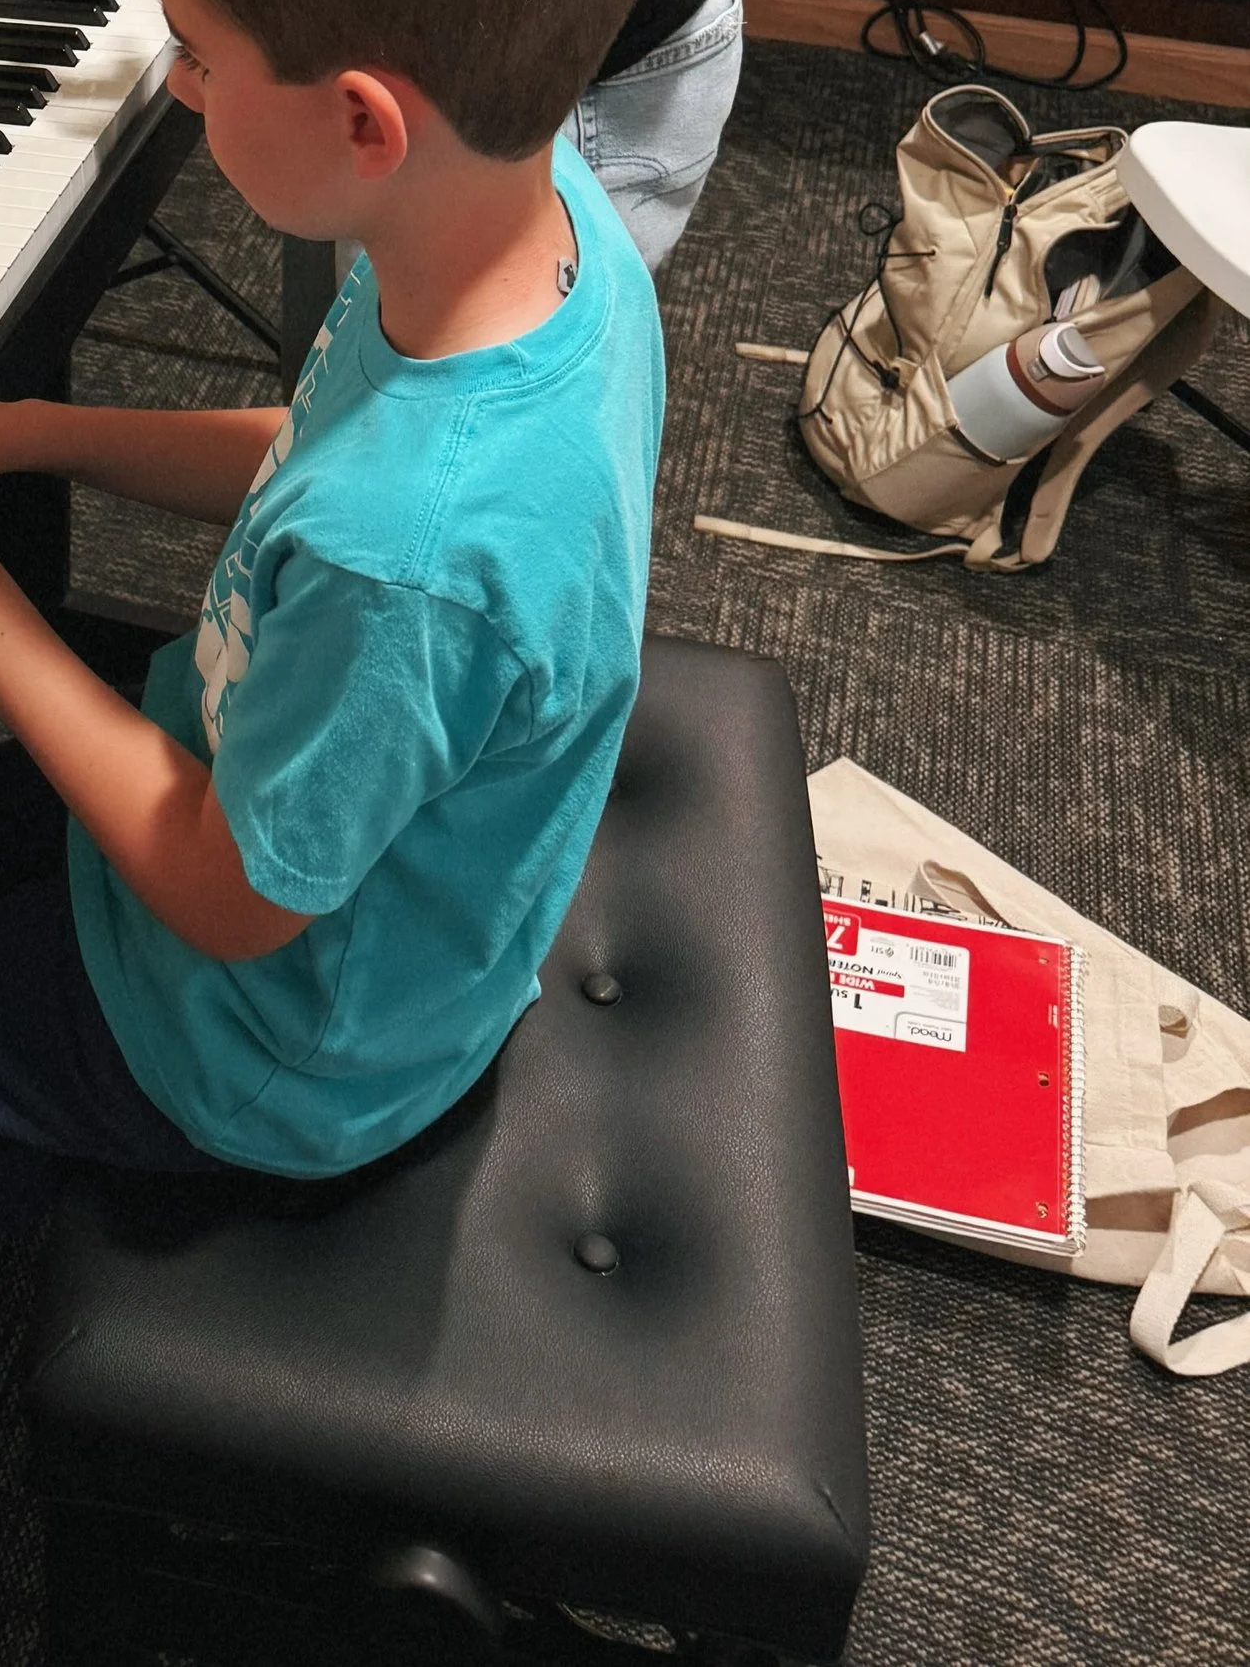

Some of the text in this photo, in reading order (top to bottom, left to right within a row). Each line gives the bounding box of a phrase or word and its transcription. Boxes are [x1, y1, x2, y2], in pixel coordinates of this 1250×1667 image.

[839, 974, 875, 990] WIDE
[854, 993, 863, 1010] 1
[911, 1026, 952, 1042] mead
